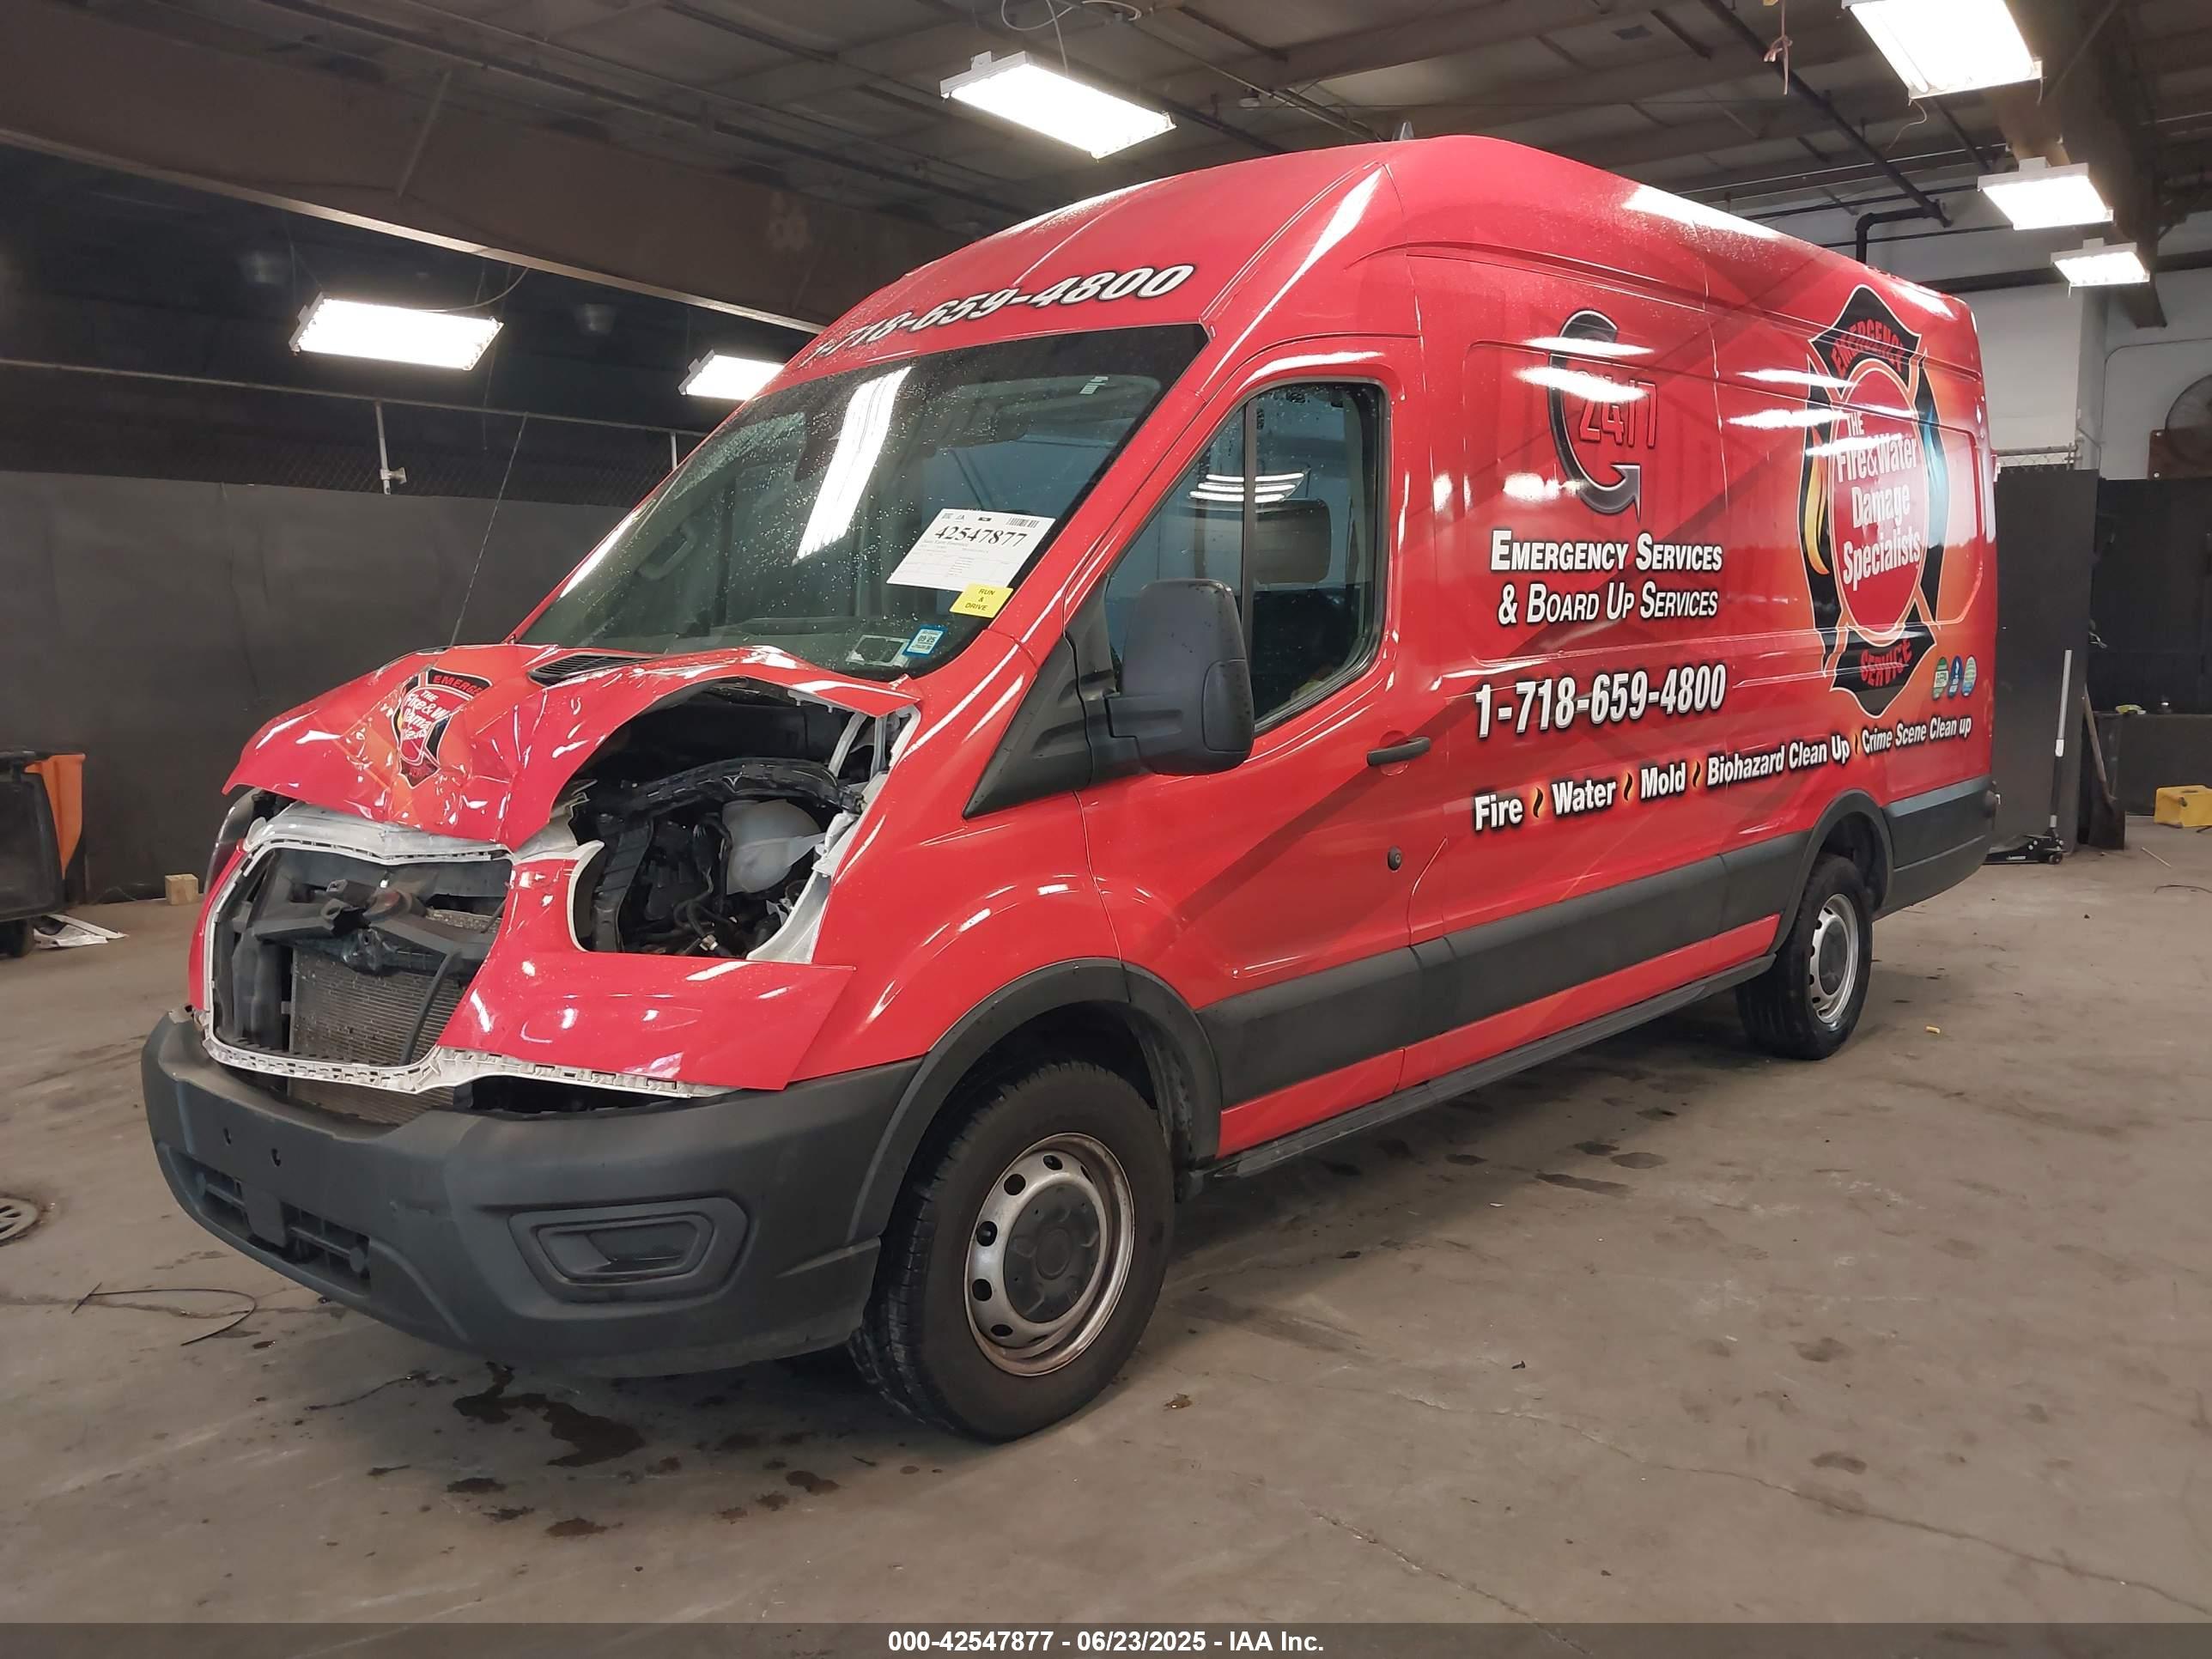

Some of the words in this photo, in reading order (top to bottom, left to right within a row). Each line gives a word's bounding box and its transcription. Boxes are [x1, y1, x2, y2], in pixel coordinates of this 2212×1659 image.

[1846, 411, 1865, 437] THE
[1851, 484, 1911, 529] Damage
[934, 525, 1028, 547] 42547877
[1843, 528, 1921, 591] Specialists
[964, 603, 988, 611] DRIVE
[1498, 584, 1517, 625] &
[1861, 638, 1912, 687] SERVICE
[420, 690, 439, 702] THE
[1475, 664, 1727, 739] 1-718-659-4800
[1474, 794, 1523, 831] Fire
[1551, 778, 1616, 816] Water
[1640, 762, 1686, 799] Mold
[1707, 745, 1785, 787] Biohazard
[1789, 739, 1827, 769] Clean
[1831, 734, 1850, 763] Up
[1861, 727, 1893, 753] Crime
[1895, 722, 1927, 746] Scene
[1929, 717, 1958, 739] Clean
[1959, 717, 1972, 738] up
